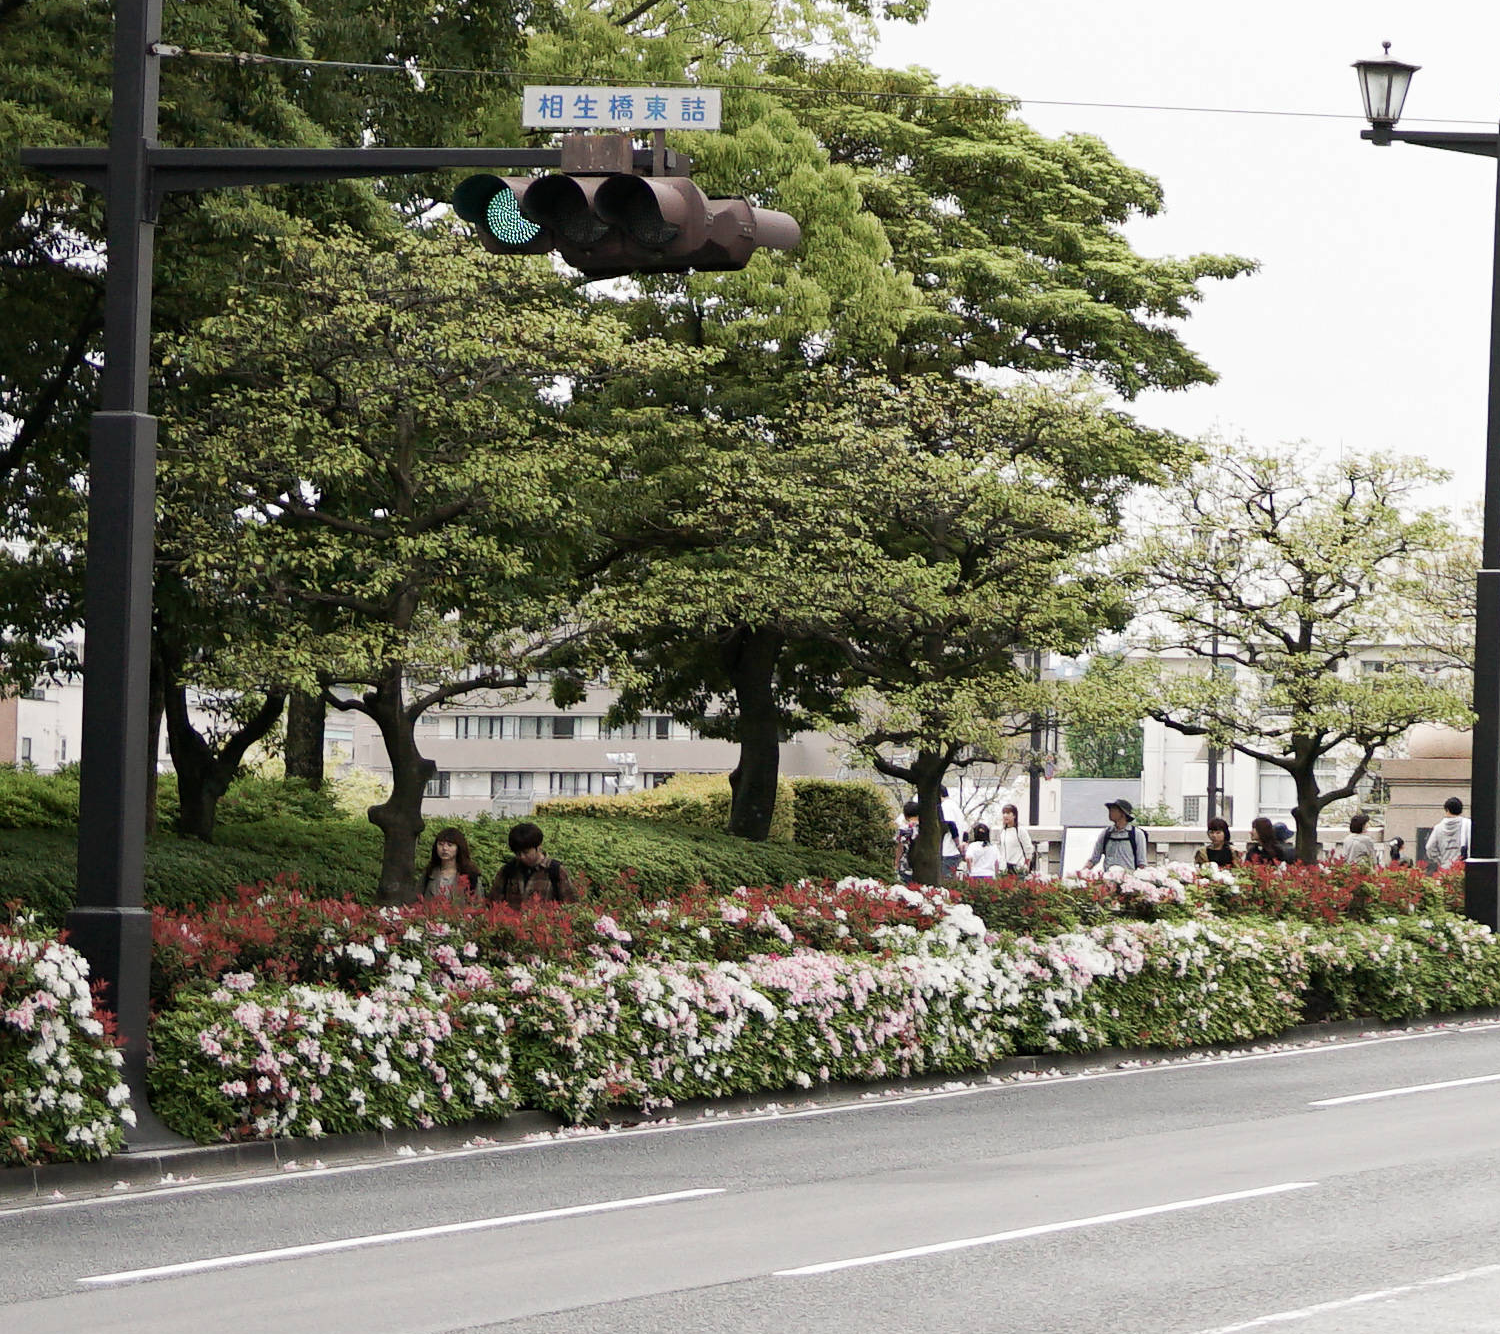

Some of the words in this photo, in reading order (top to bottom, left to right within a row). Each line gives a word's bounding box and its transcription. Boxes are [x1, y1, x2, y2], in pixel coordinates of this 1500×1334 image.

[538, 94, 706, 122] 相生橋東詰
